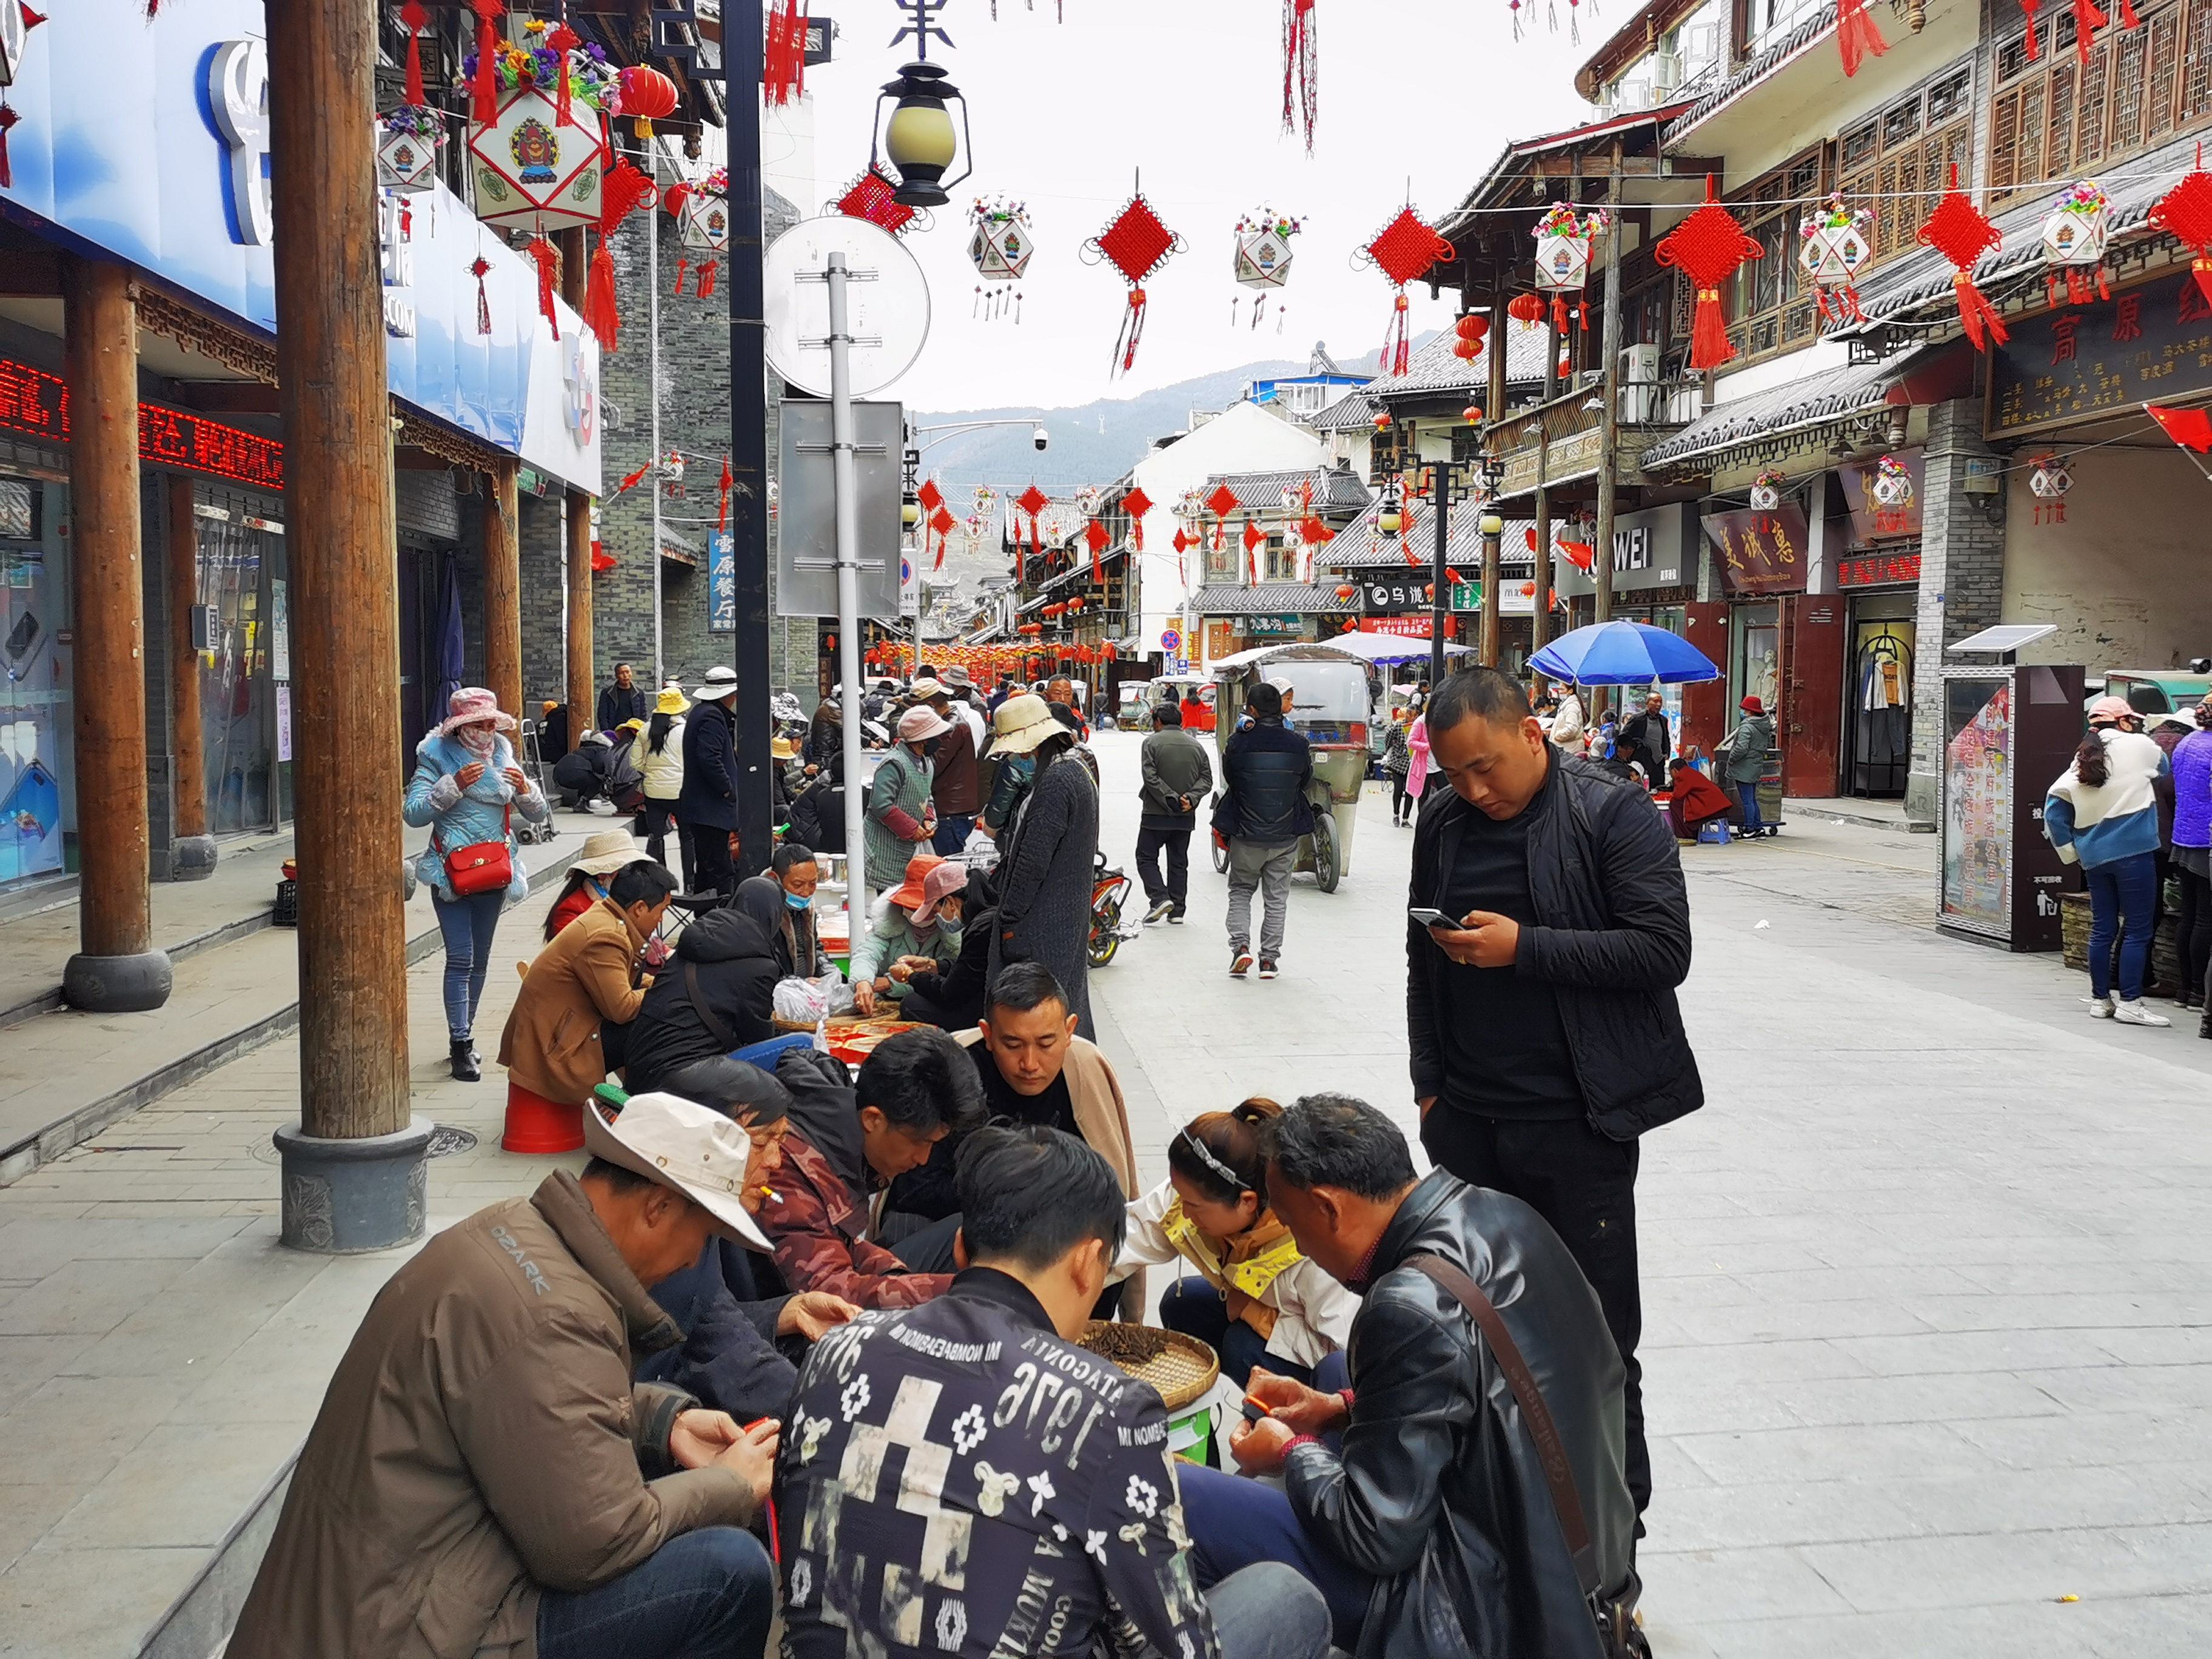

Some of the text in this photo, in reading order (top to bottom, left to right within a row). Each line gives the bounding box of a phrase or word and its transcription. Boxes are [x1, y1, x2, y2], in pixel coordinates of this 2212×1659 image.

[383, 293, 417, 338] COM
[713, 534, 736, 618] 雪原餐厅
